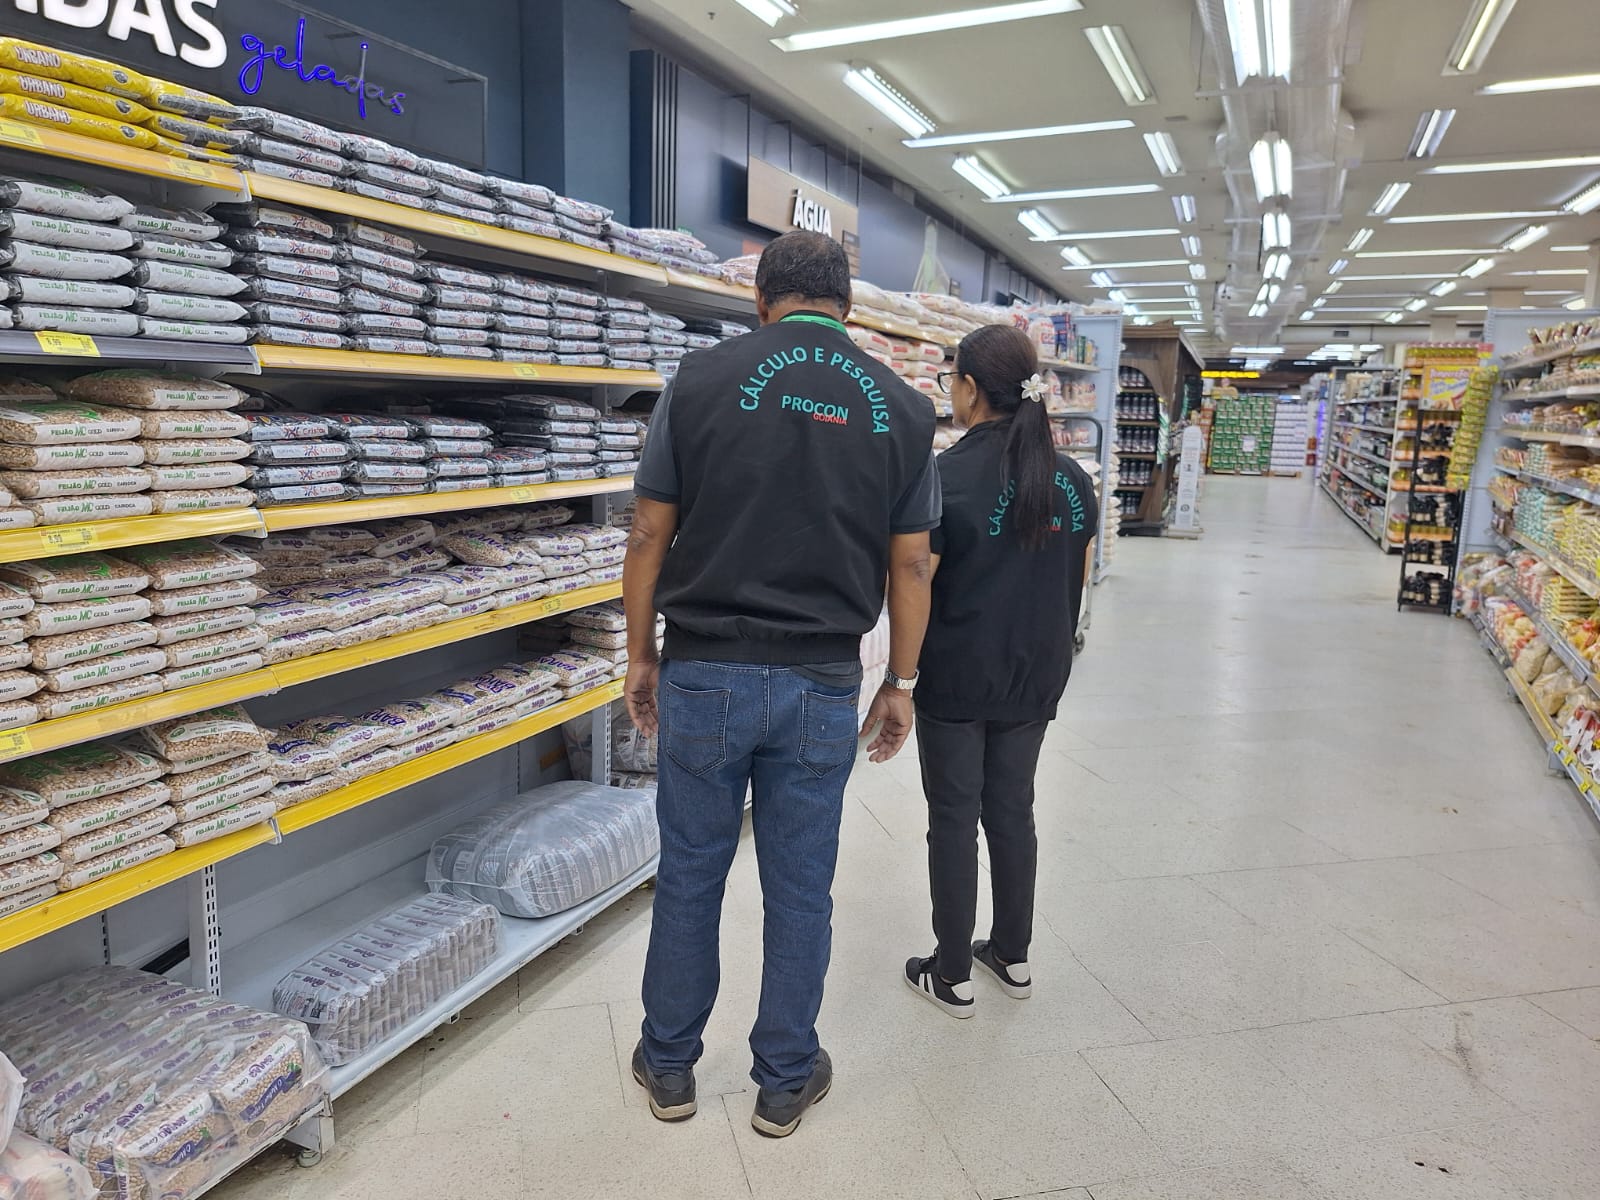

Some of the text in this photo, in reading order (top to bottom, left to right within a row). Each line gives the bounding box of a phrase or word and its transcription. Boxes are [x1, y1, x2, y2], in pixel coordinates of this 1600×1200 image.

[793, 189, 832, 237] ÁGUA
[740, 347, 889, 433] CÁLCULO E PESQUISA
[782, 396, 848, 420] PROCON
[1055, 471, 1085, 532] ESQUISA
